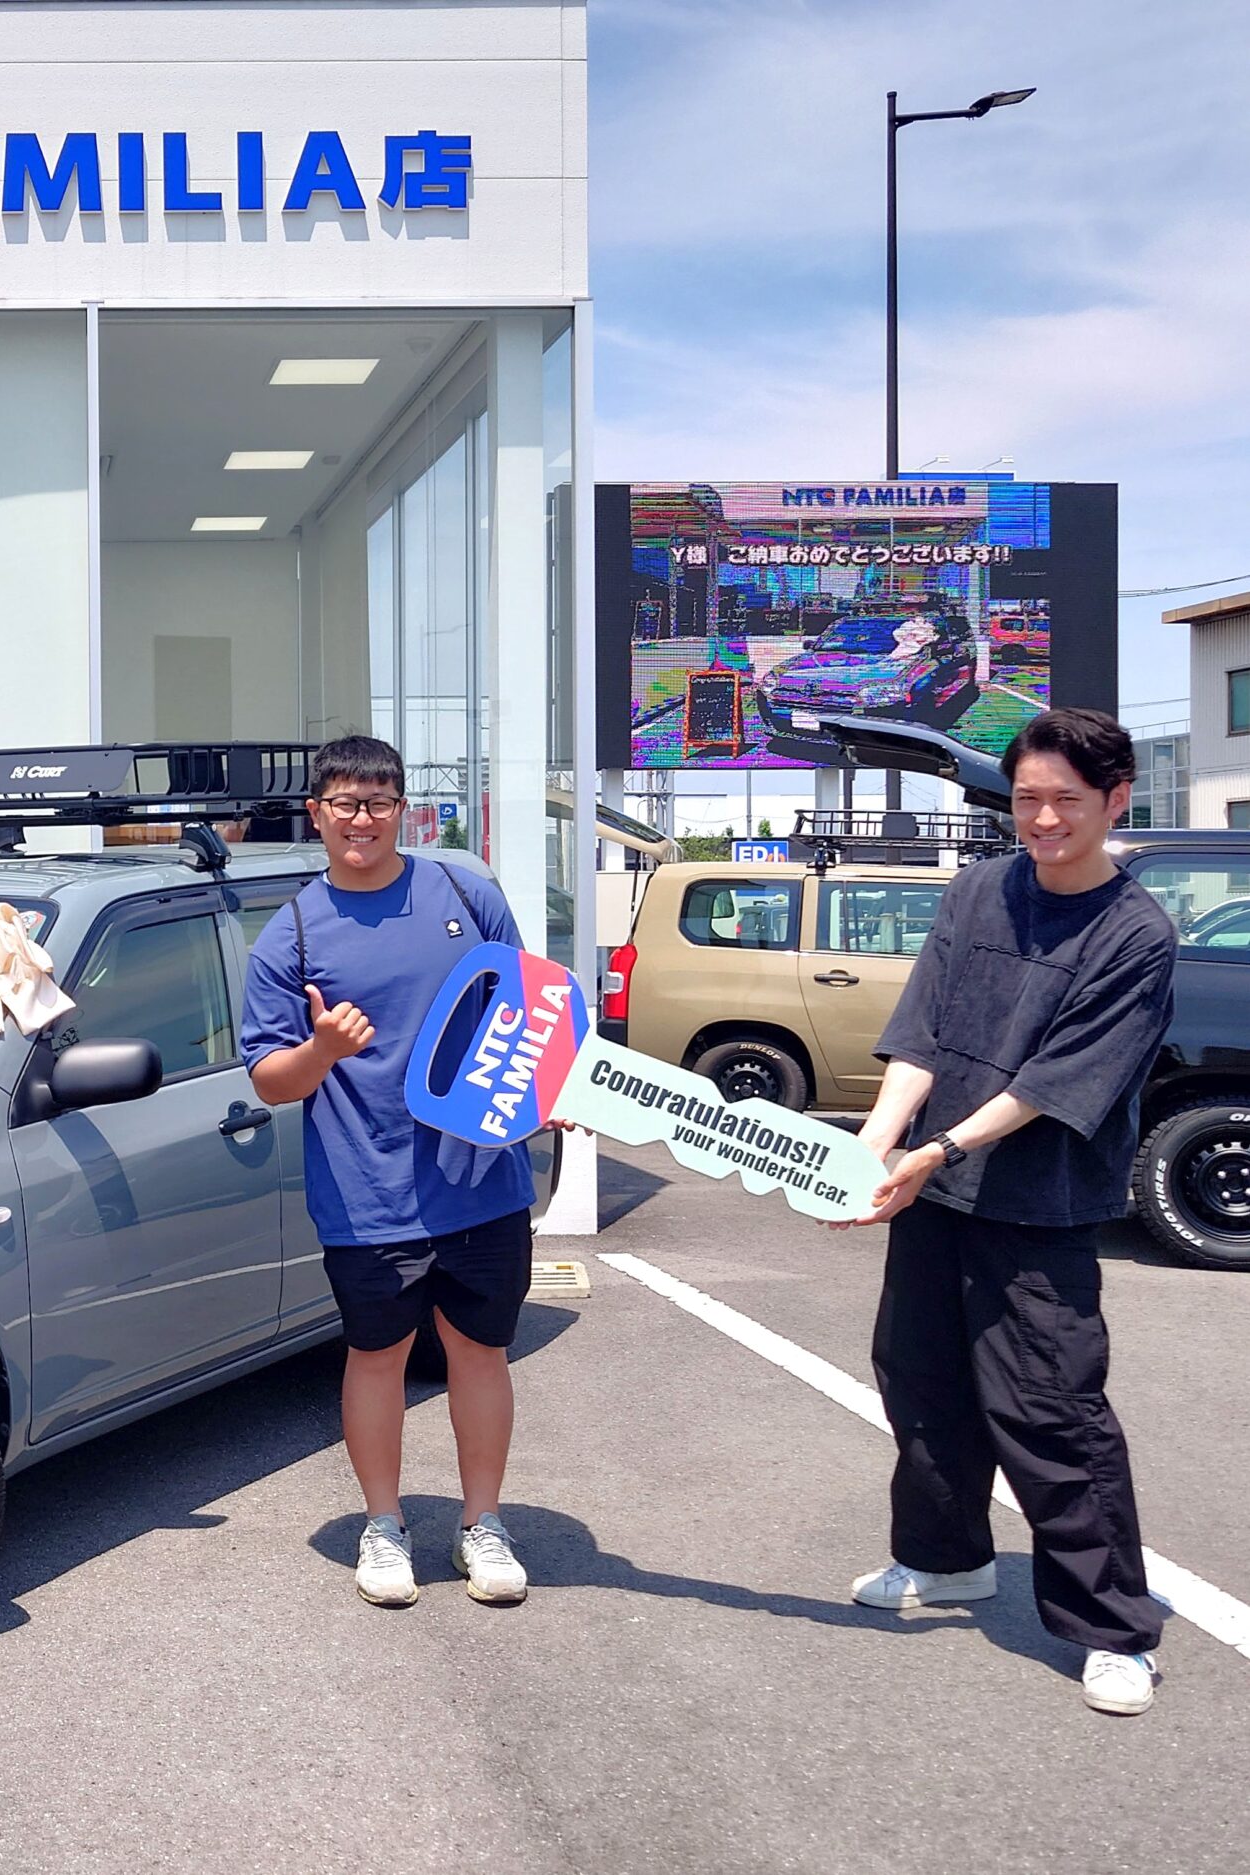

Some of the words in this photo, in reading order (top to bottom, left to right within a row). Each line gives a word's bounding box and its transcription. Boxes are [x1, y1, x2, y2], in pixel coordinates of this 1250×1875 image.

[782, 487, 836, 506] NTC
[465, 1001, 524, 1089] NTC
[480, 984, 573, 1138] FAMILIA
[739, 1043, 781, 1060] DUNLOP
[590, 1059, 831, 1172] Congratulations!!
[671, 1124, 716, 1152] your
[718, 1141, 814, 1191] wonderful
[813, 1180, 849, 1206] car.
[1154, 1158, 1170, 1210] TIRES
[1163, 1211, 1204, 1247] TOYO
